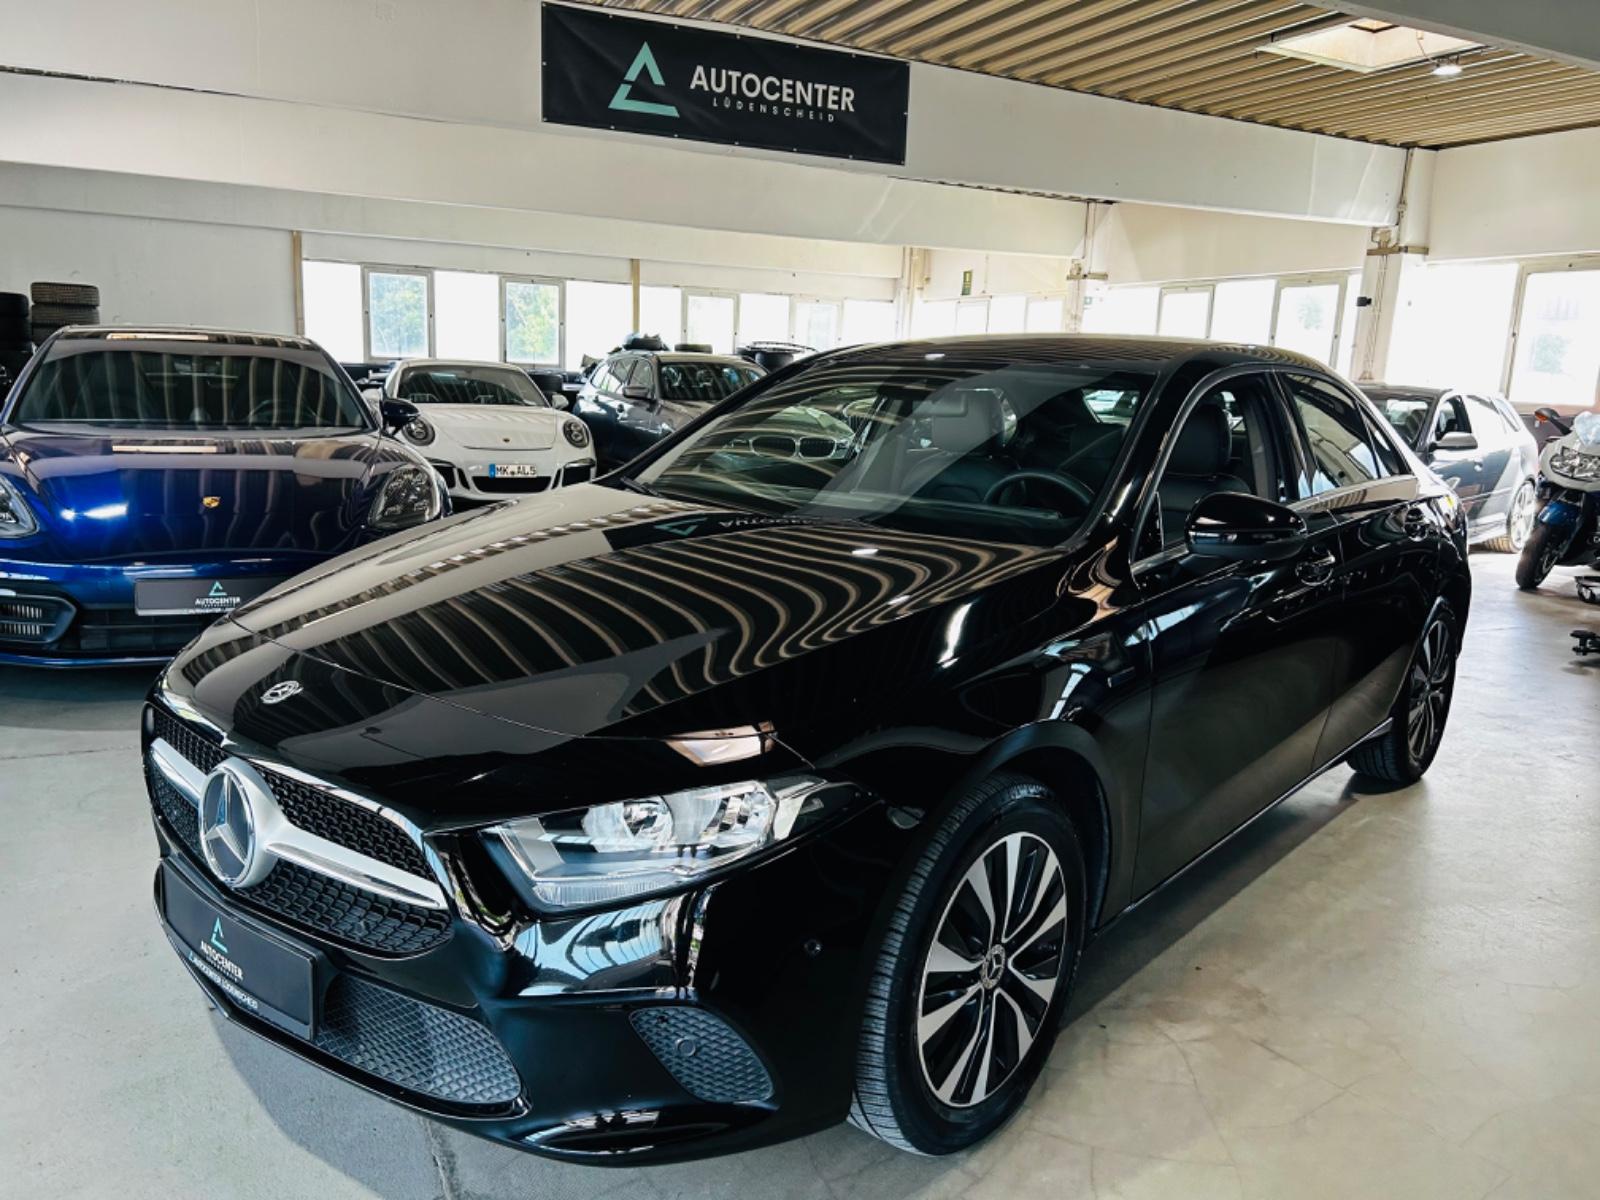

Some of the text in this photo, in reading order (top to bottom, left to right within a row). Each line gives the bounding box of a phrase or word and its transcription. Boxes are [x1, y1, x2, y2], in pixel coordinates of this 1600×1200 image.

[689, 64, 856, 113] AUTOCENTER
[712, 96, 835, 123] LÜDENSCHEID
[200, 940, 244, 981] AUTOCENTER
